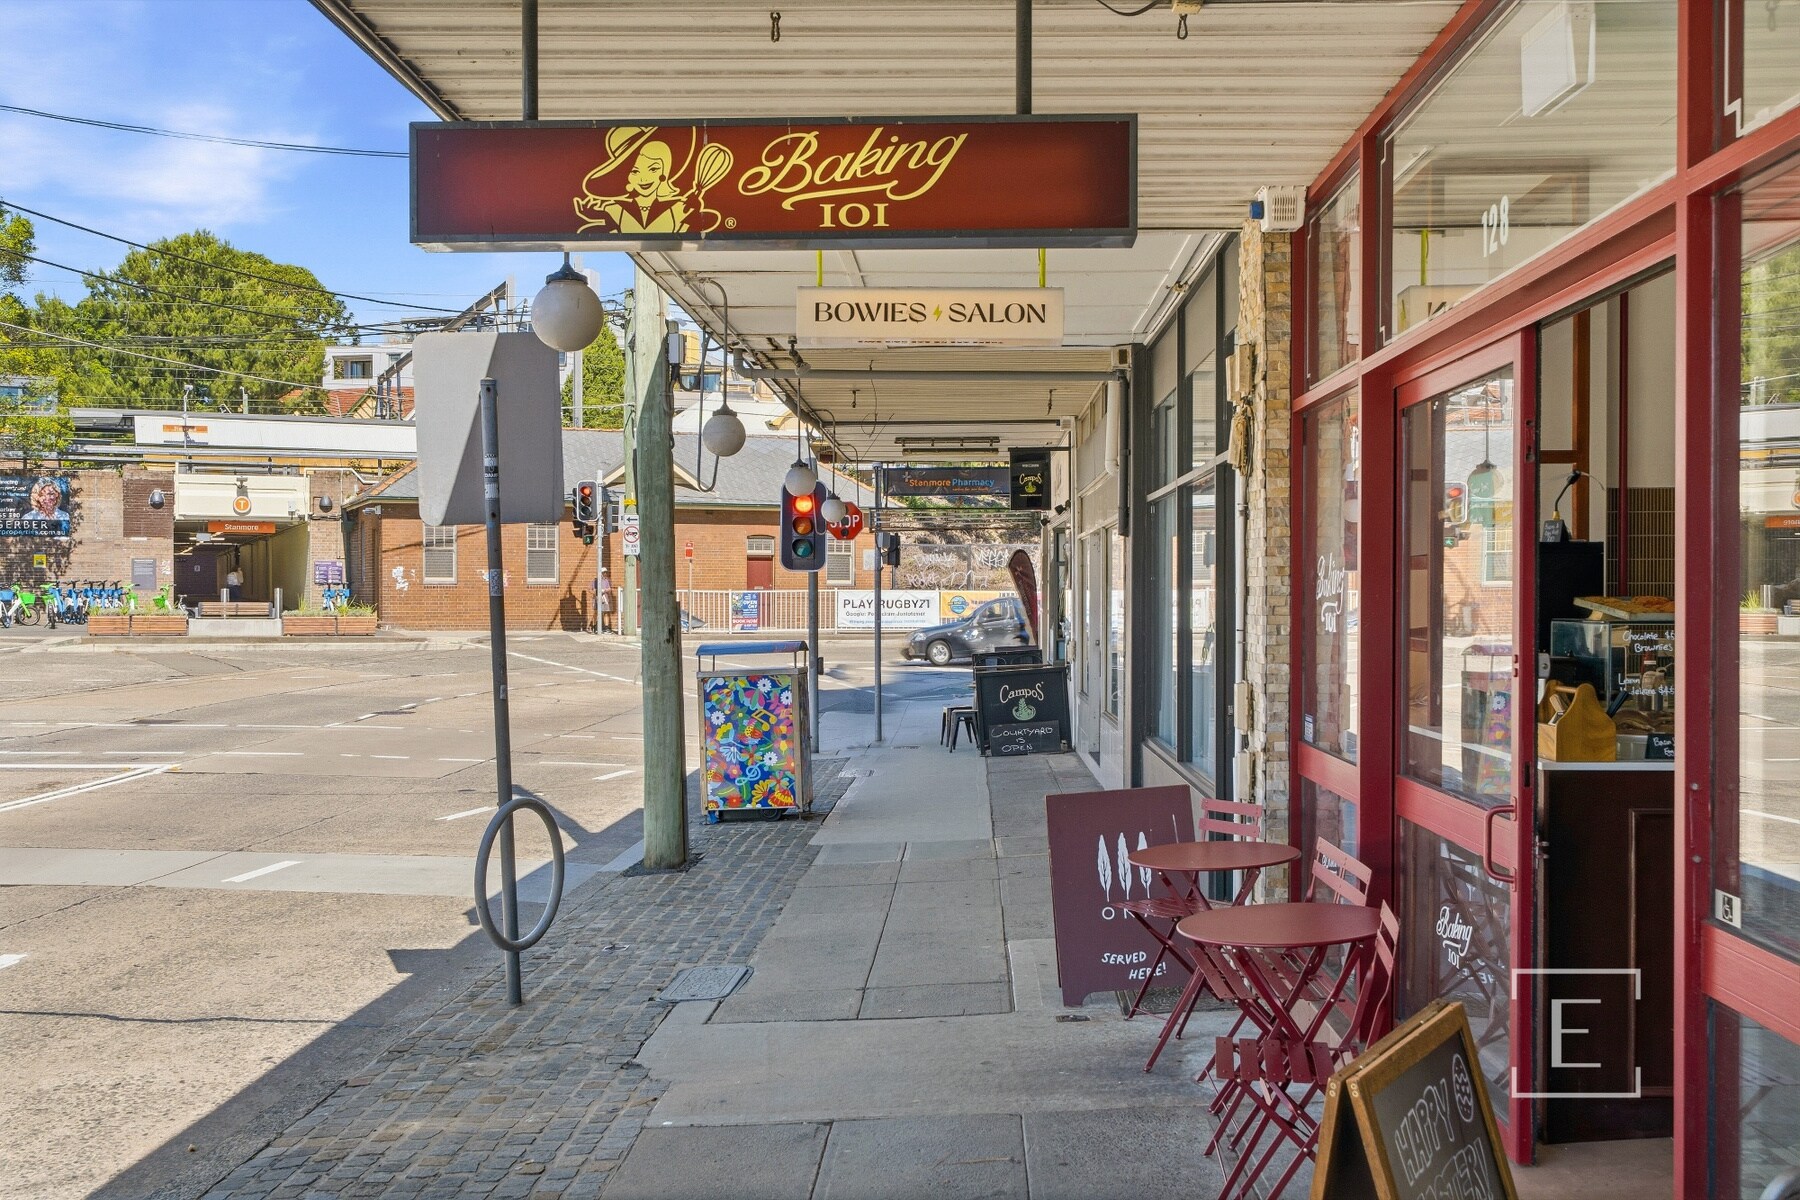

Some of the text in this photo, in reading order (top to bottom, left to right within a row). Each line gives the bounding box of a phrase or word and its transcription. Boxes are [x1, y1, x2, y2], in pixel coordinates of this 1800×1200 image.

[738, 126, 968, 211] Baking
[1481, 195, 1509, 258] 128
[814, 302, 1046, 324] BOWIES SALON
[909, 478, 995, 487] Stanmore Pharmacy
[1316, 552, 1345, 615] Baking
[843, 599, 873, 609] PLAY
[1634, 643, 1674, 652] Brownies
[991, 727, 1053, 738] COURTYARD
[1001, 744, 1033, 753] OPEN
[1436, 906, 1473, 956] Baking
[1101, 951, 1147, 965] SERVED
[1394, 1078, 1455, 1187] HAPPY
